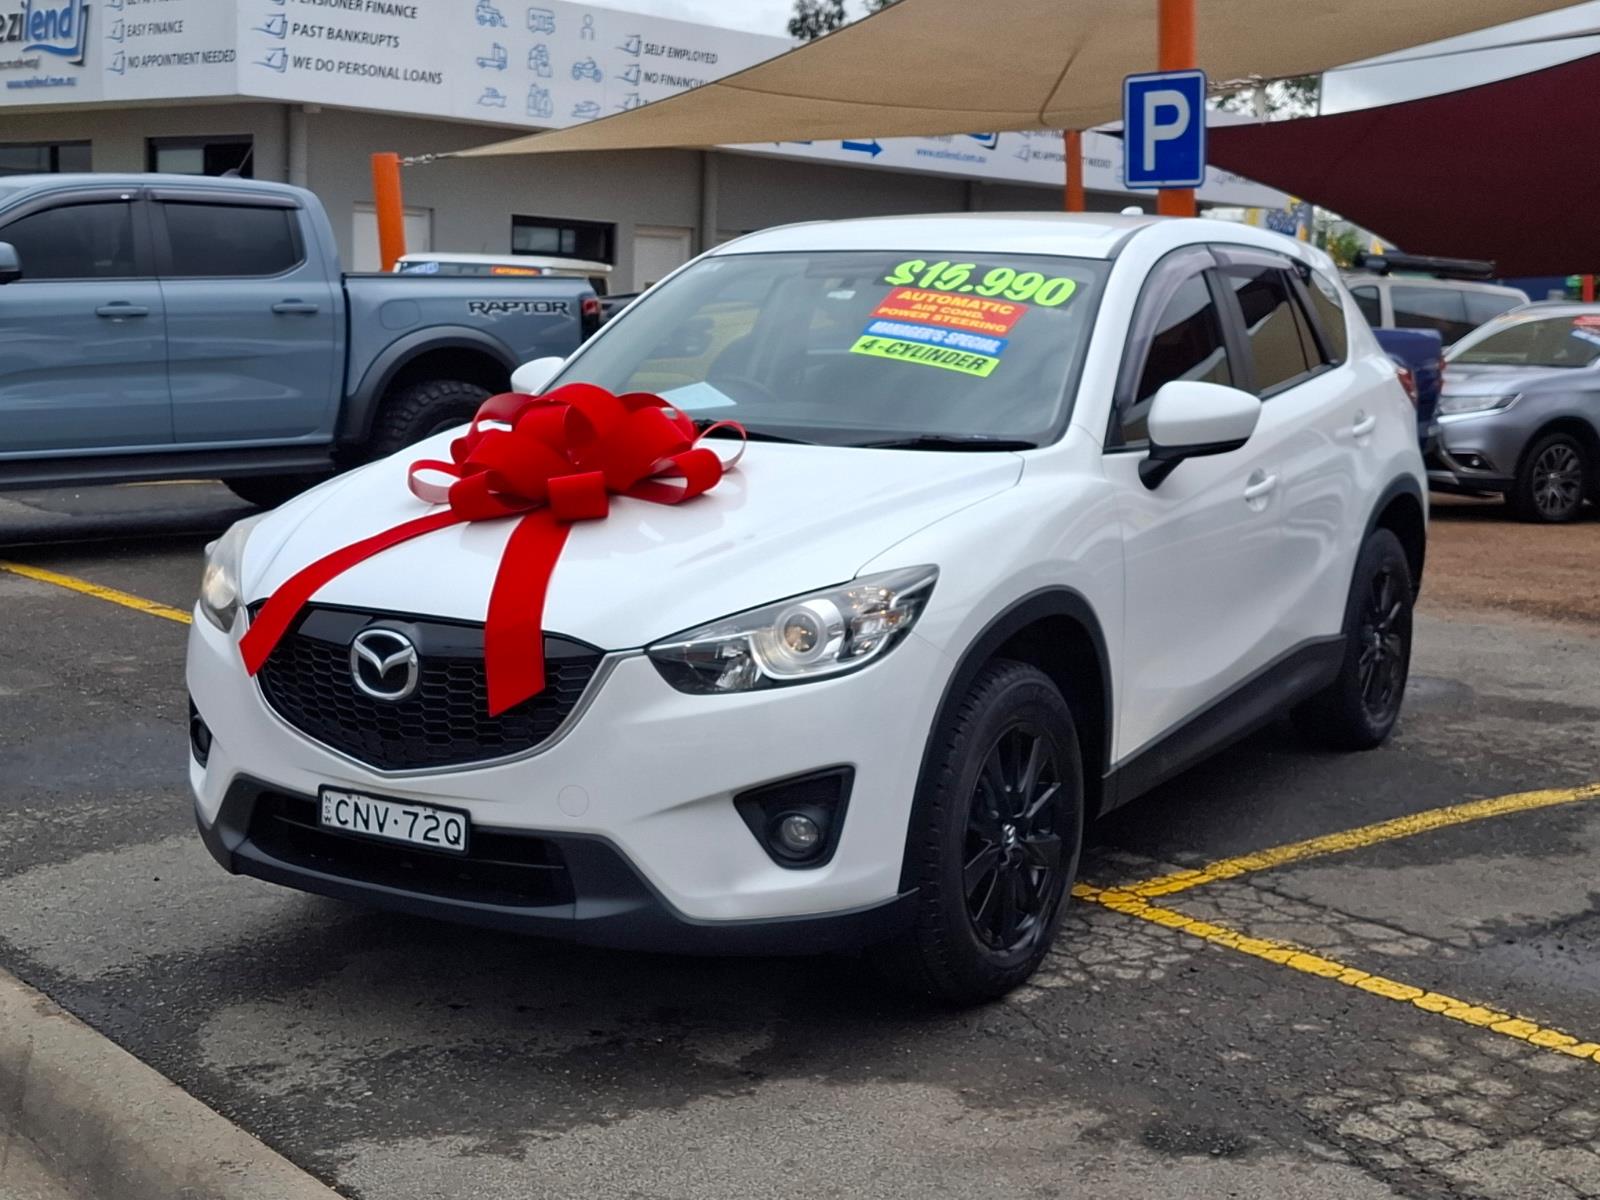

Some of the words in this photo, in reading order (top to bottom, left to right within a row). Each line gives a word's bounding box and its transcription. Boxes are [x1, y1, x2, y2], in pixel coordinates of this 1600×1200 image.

[365, 1, 418, 19] FINANCE
[127, 23, 147, 37] EASY
[149, 20, 184, 35] FINANCE
[292, 23, 324, 40] PAST
[327, 28, 400, 48] BANKRUPTS
[128, 56, 140, 68] NO
[141, 52, 201, 68] APPOINTMENT
[202, 50, 236, 63] NEEDED
[644, 43, 665, 57] SELF
[667, 46, 718, 64] EMPLOYED
[292, 56, 312, 70] WE
[315, 58, 335, 72] DO
[337, 62, 401, 80] PERSONAL
[403, 68, 443, 84] LOANS
[644, 72, 658, 84] NO
[1143, 90, 1190, 171] P
[469, 301, 570, 315] RAPTOR
[897, 291, 1015, 315] AUTOMATIC
[912, 303, 938, 312] AIR
[877, 307, 930, 320] POWER
[932, 313, 1008, 333] STEERING
[324, 795, 332, 823] NSW
